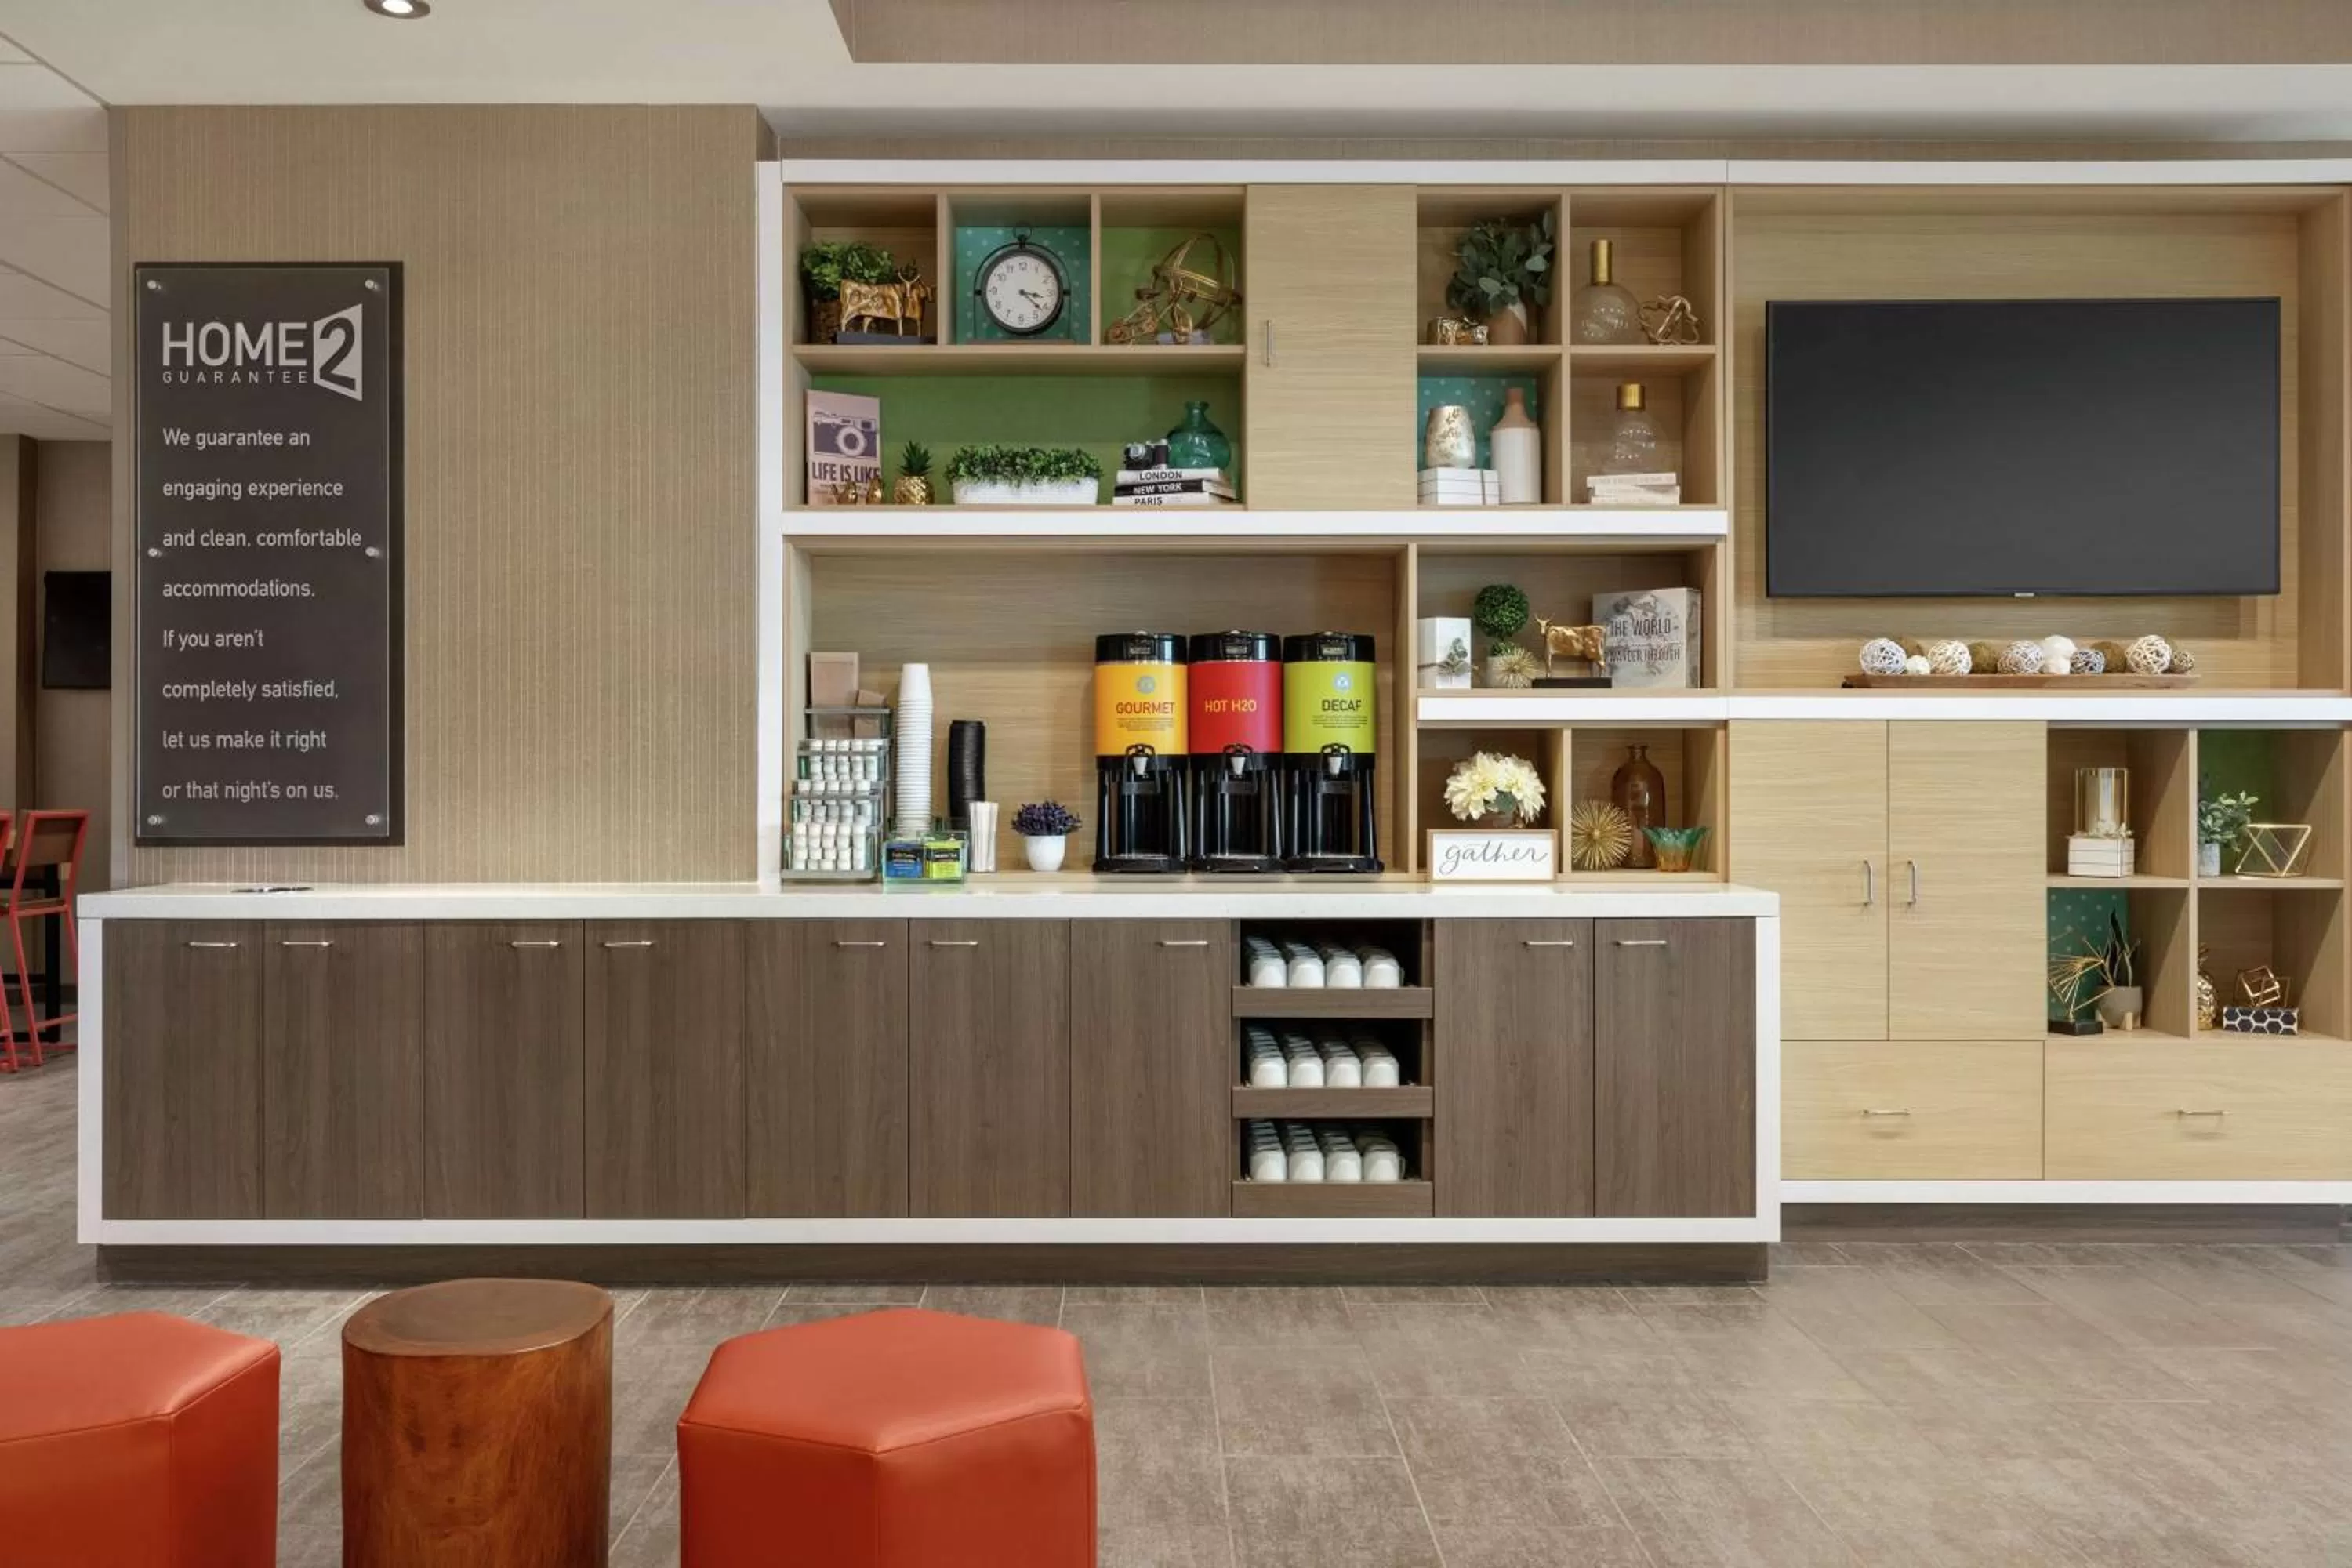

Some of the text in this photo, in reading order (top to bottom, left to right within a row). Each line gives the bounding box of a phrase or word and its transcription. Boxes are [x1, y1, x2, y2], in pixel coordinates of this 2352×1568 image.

[162, 371, 307, 383] GUARANTEE
[162, 427, 310, 451] We guarantee an
[811, 461, 837, 481] LIFE
[840, 463, 852, 482] IS
[1138, 470, 1184, 481] LONDON
[162, 478, 343, 501] engaging experience
[1133, 482, 1183, 495] NEW YORK
[1134, 496, 1163, 506] PARIS
[162, 528, 195, 546] and
[256, 528, 361, 546] comfortable
[162, 579, 315, 597] accommodations.
[1610, 617, 1671, 637] THE WORLD
[163, 629, 264, 652] If you aren't
[162, 679, 339, 702] completely satisfied,
[1116, 702, 1175, 715] GOURMET
[1204, 699, 1229, 713] HOT
[1321, 699, 1362, 712] DECAF
[162, 730, 327, 753] let us make it right
[162, 780, 339, 804] or that night's on us.
[1439, 840, 1548, 876] gather
